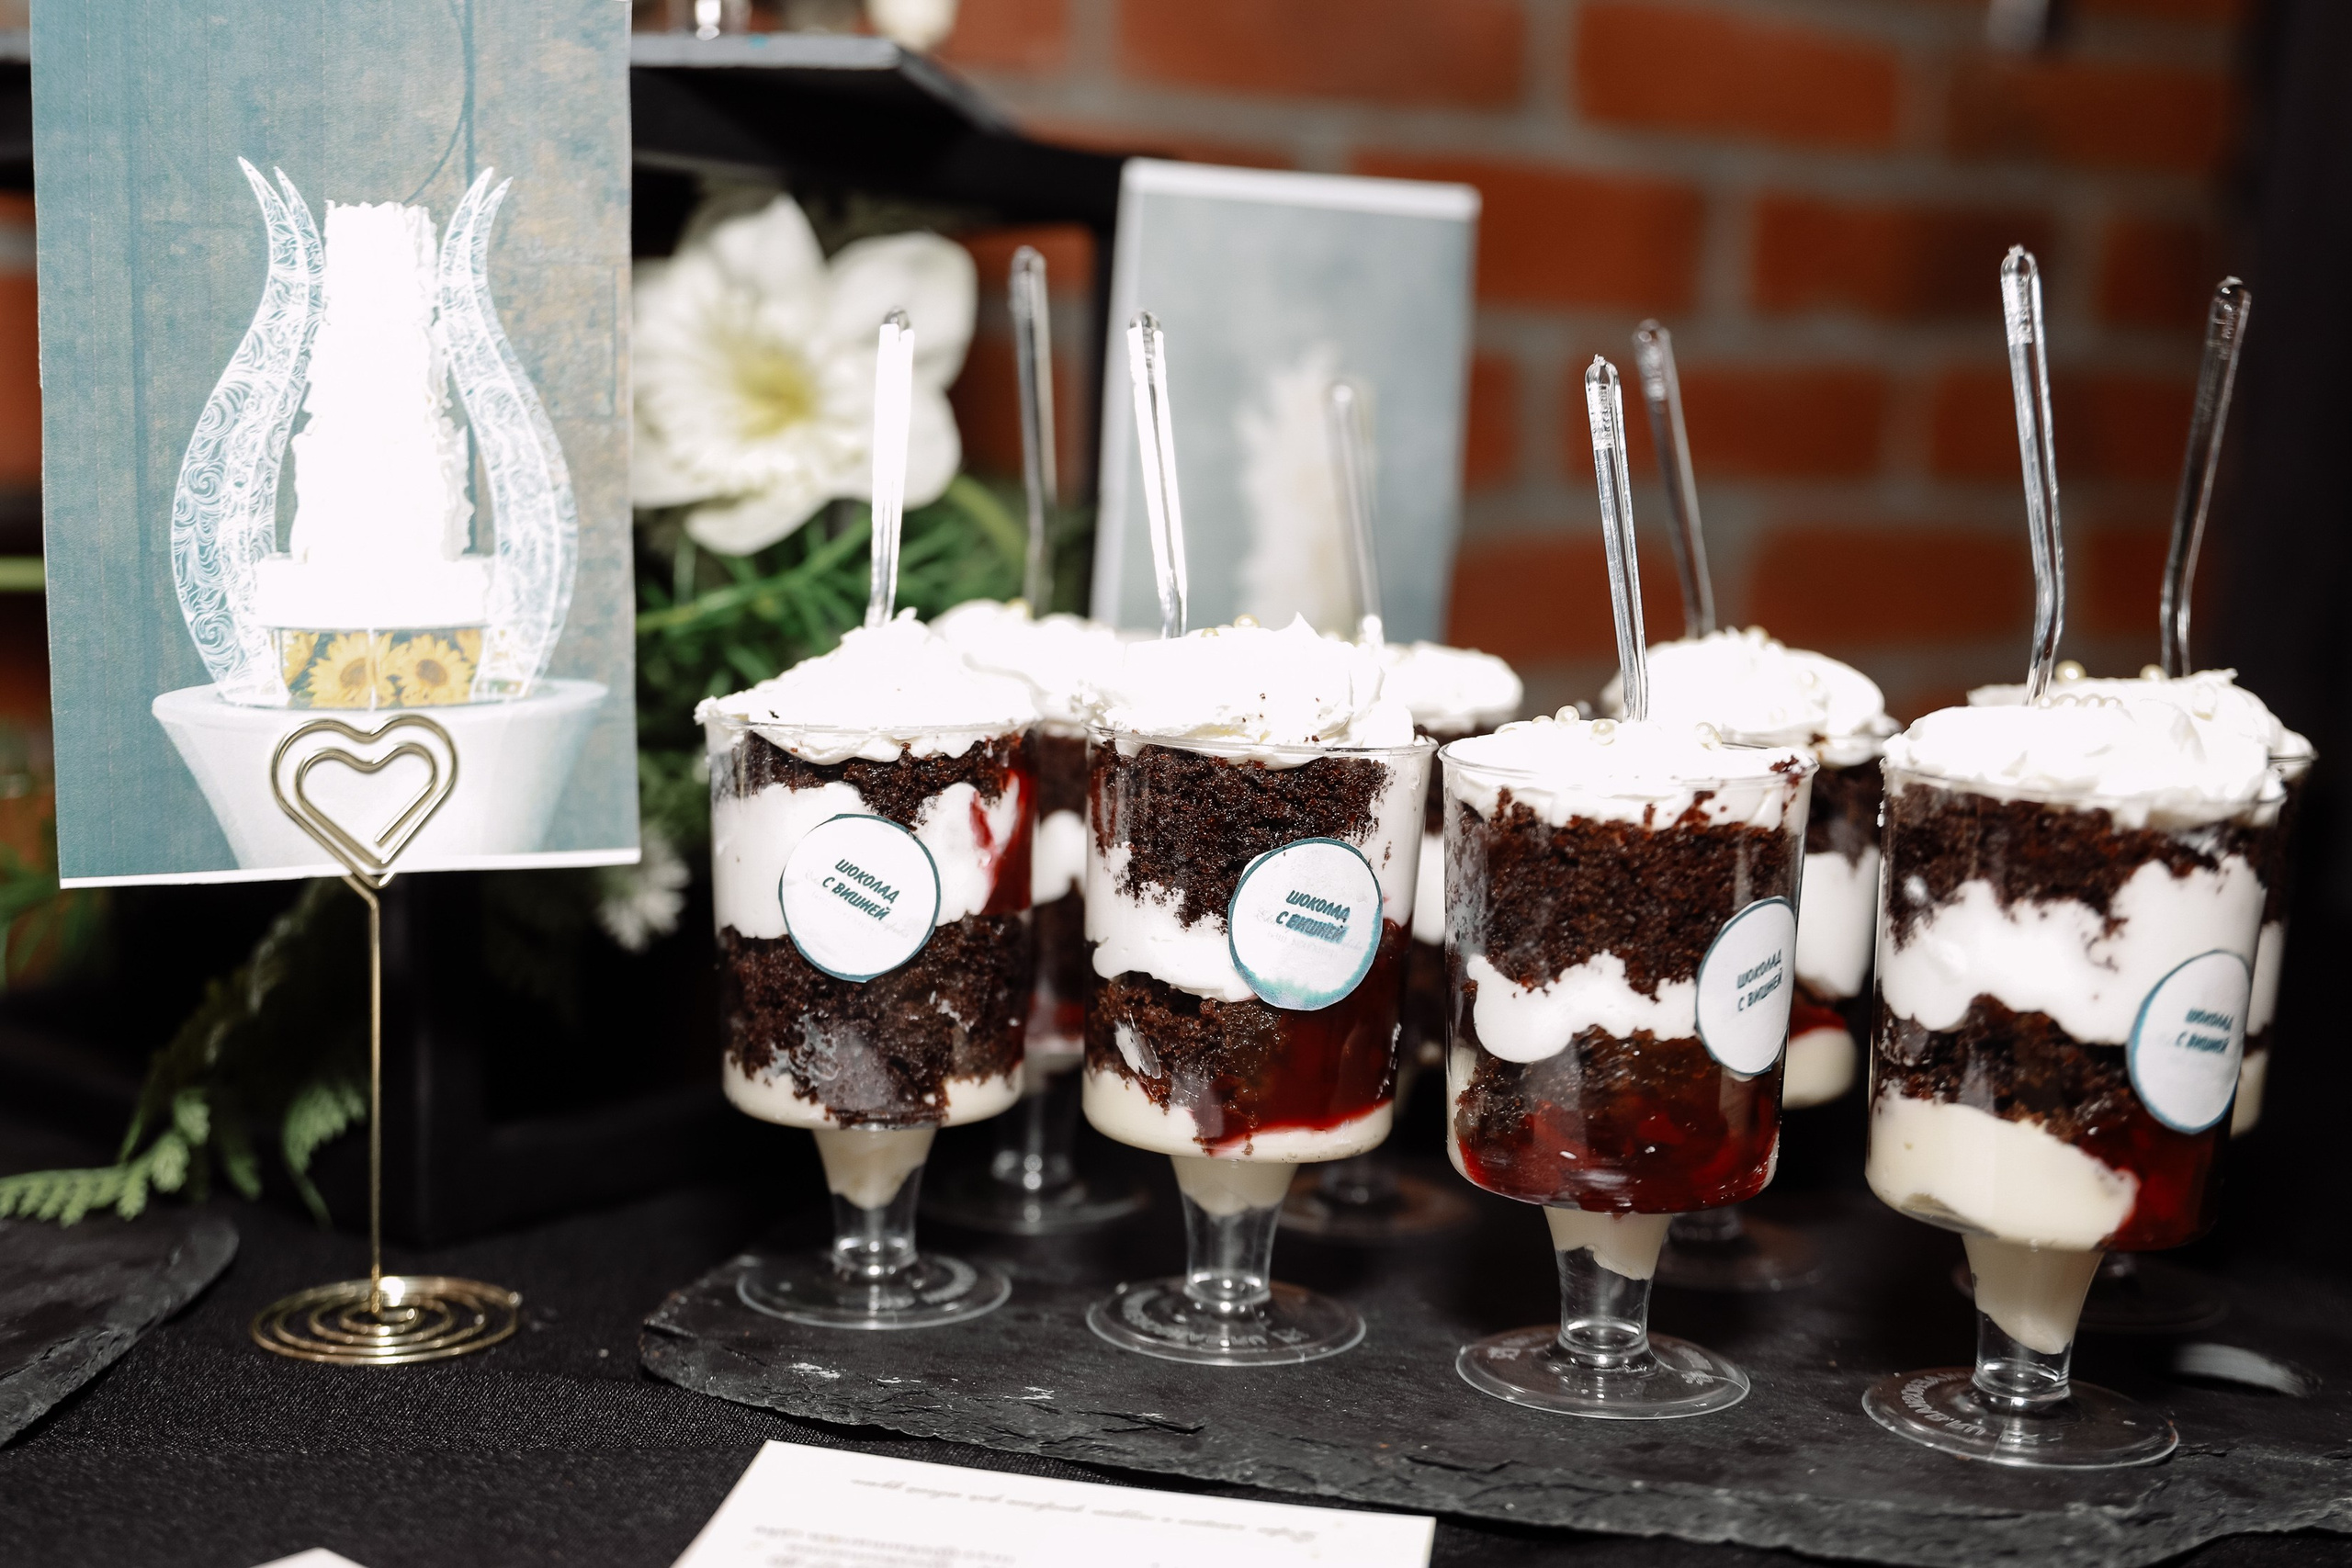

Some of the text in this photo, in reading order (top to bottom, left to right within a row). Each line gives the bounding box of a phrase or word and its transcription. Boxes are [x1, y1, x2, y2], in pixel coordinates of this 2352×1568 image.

[822, 876, 836, 888] С
[831, 882, 892, 921] ВИШНЕЙ
[834, 858, 900, 905] ШОКОЛАД
[1275, 910, 1290, 925] С
[1284, 913, 1348, 944] ВИШНЕЙ
[1285, 889, 1351, 924] ШОКОЛАД
[1736, 948, 1782, 989] ШОКОЛАД
[1737, 966, 1783, 1012] С ВИШНЕЙ
